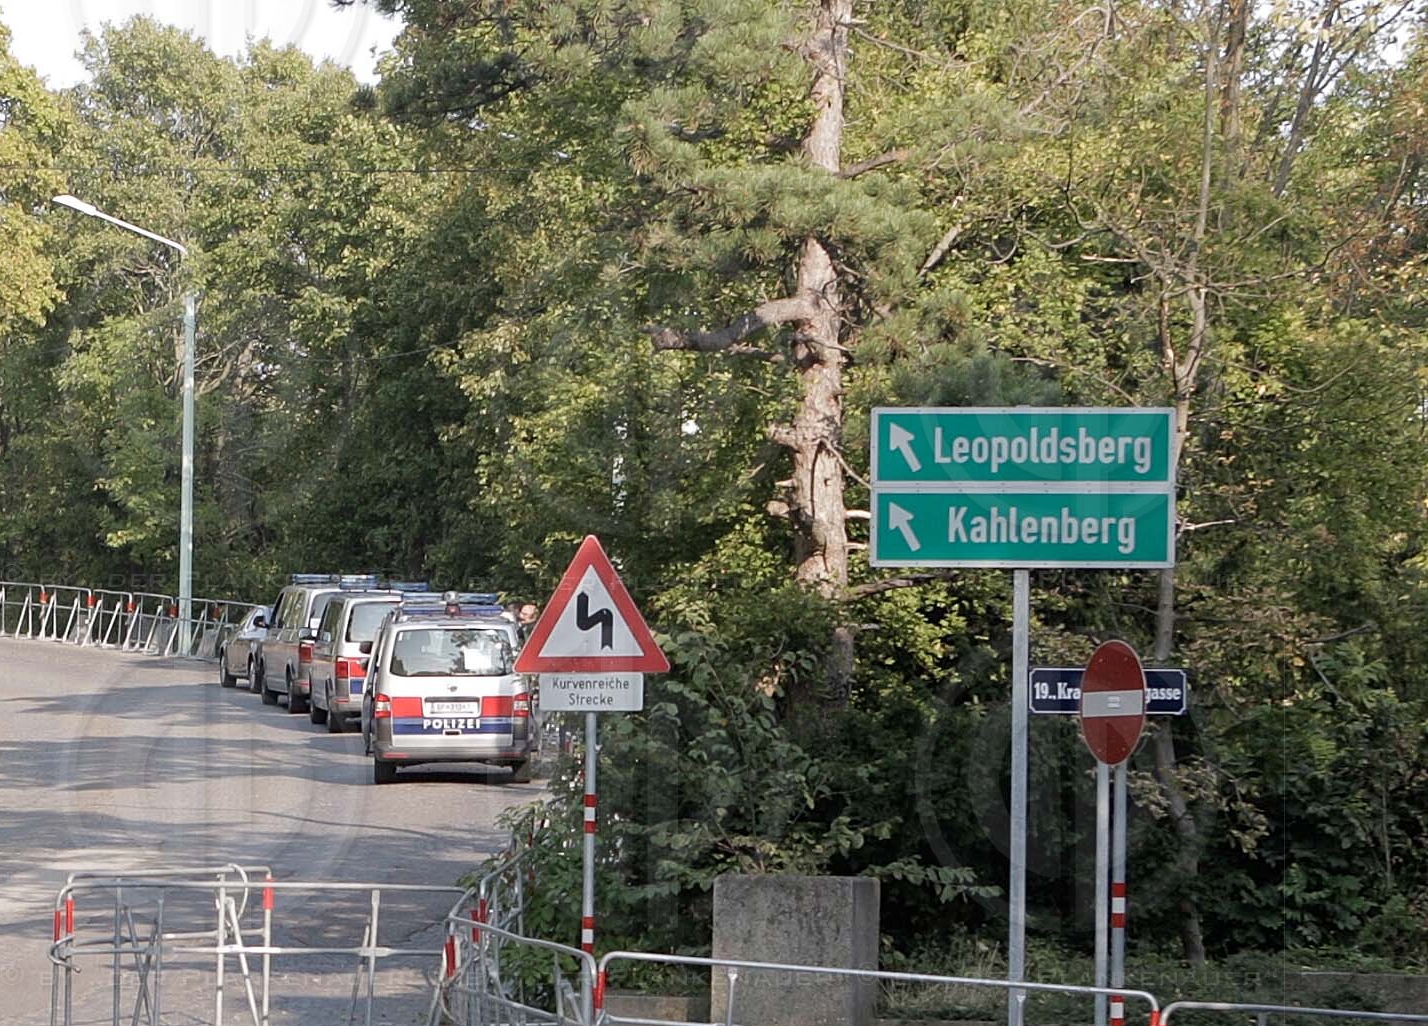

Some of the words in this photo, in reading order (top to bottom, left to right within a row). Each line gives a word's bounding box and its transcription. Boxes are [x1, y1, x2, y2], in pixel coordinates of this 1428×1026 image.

[933, 427, 1152, 474] Leopoldsberg
[948, 507, 1136, 554] Kahlenberg
[552, 677, 629, 689] Kurvenreiche
[569, 693, 614, 705] Strecke
[423, 718, 480, 729] POLIZEI
